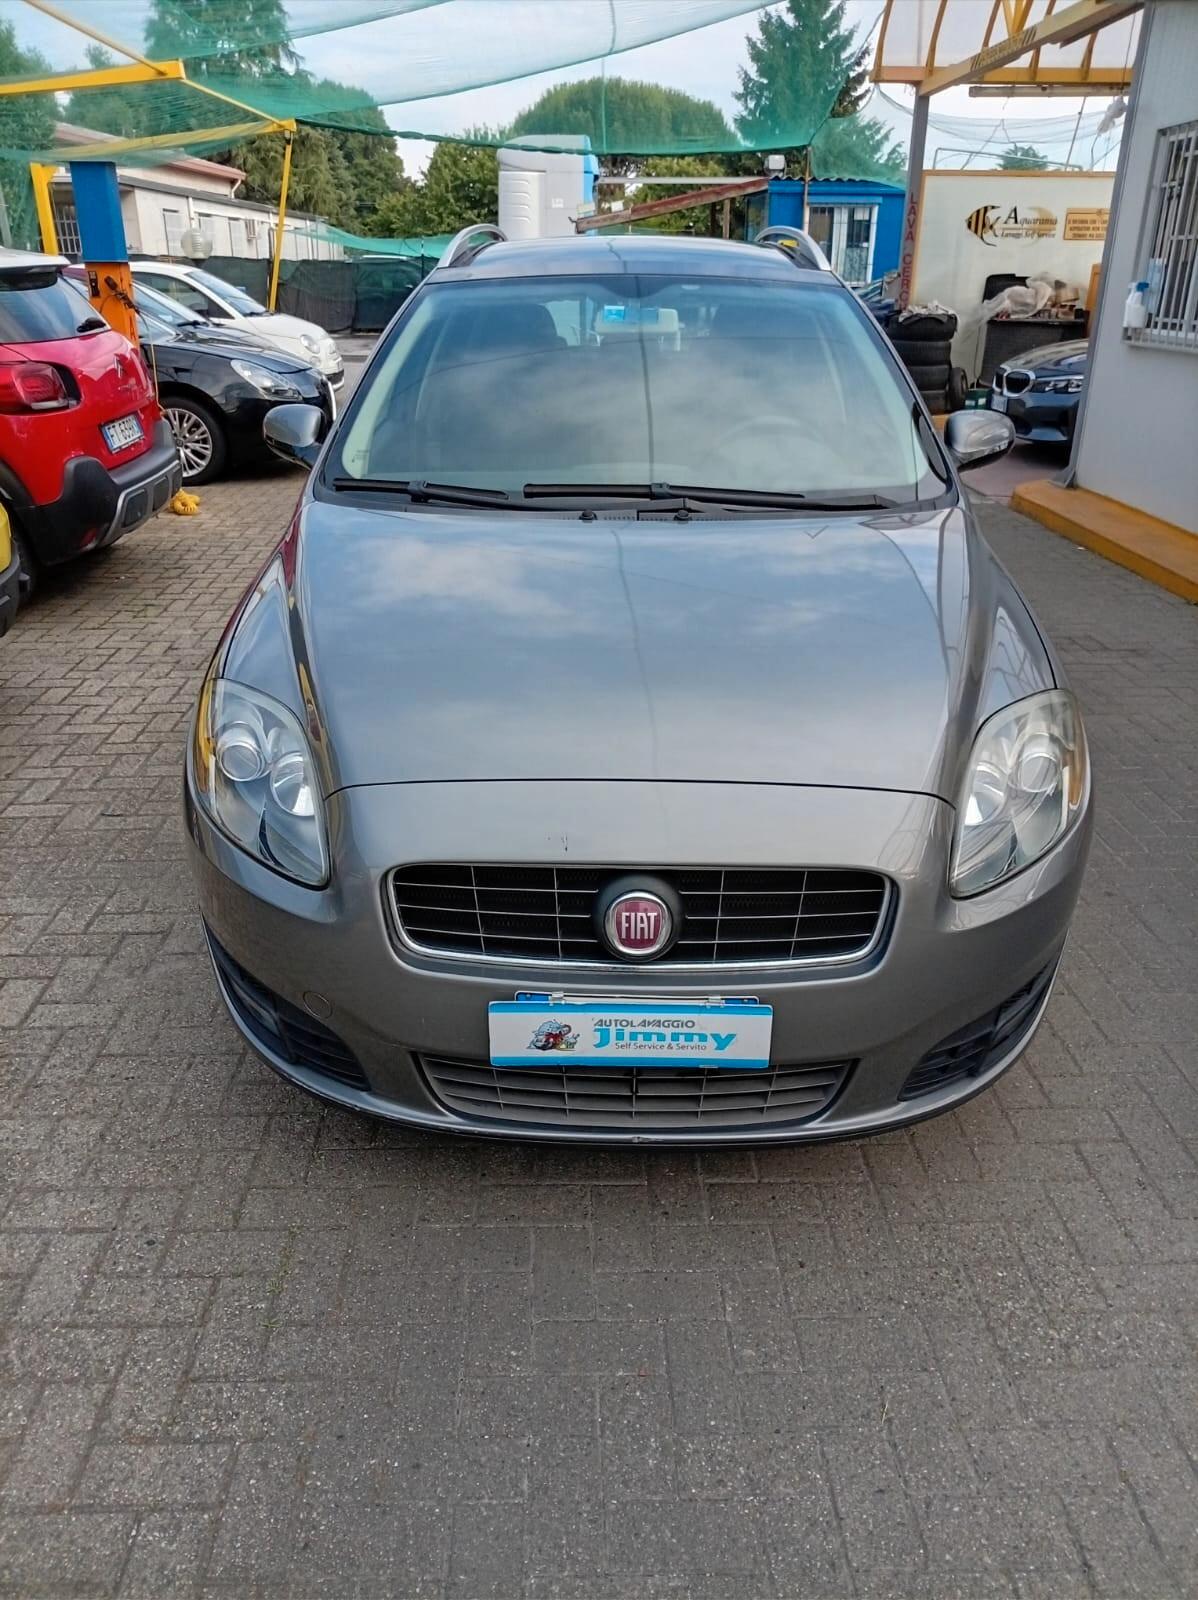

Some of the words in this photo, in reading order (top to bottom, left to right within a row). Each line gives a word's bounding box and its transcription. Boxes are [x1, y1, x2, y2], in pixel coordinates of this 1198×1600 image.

[905, 192, 918, 241] LAVA
[1004, 206, 1058, 226] Aquarama
[621, 911, 658, 940] FIAT
[593, 1018, 696, 1029] AUTOLAVAGGIO
[615, 1042, 631, 1050] Self
[633, 1042, 665, 1050] Service
[667, 1042, 673, 1050] &
[674, 1042, 707, 1051] Servito
